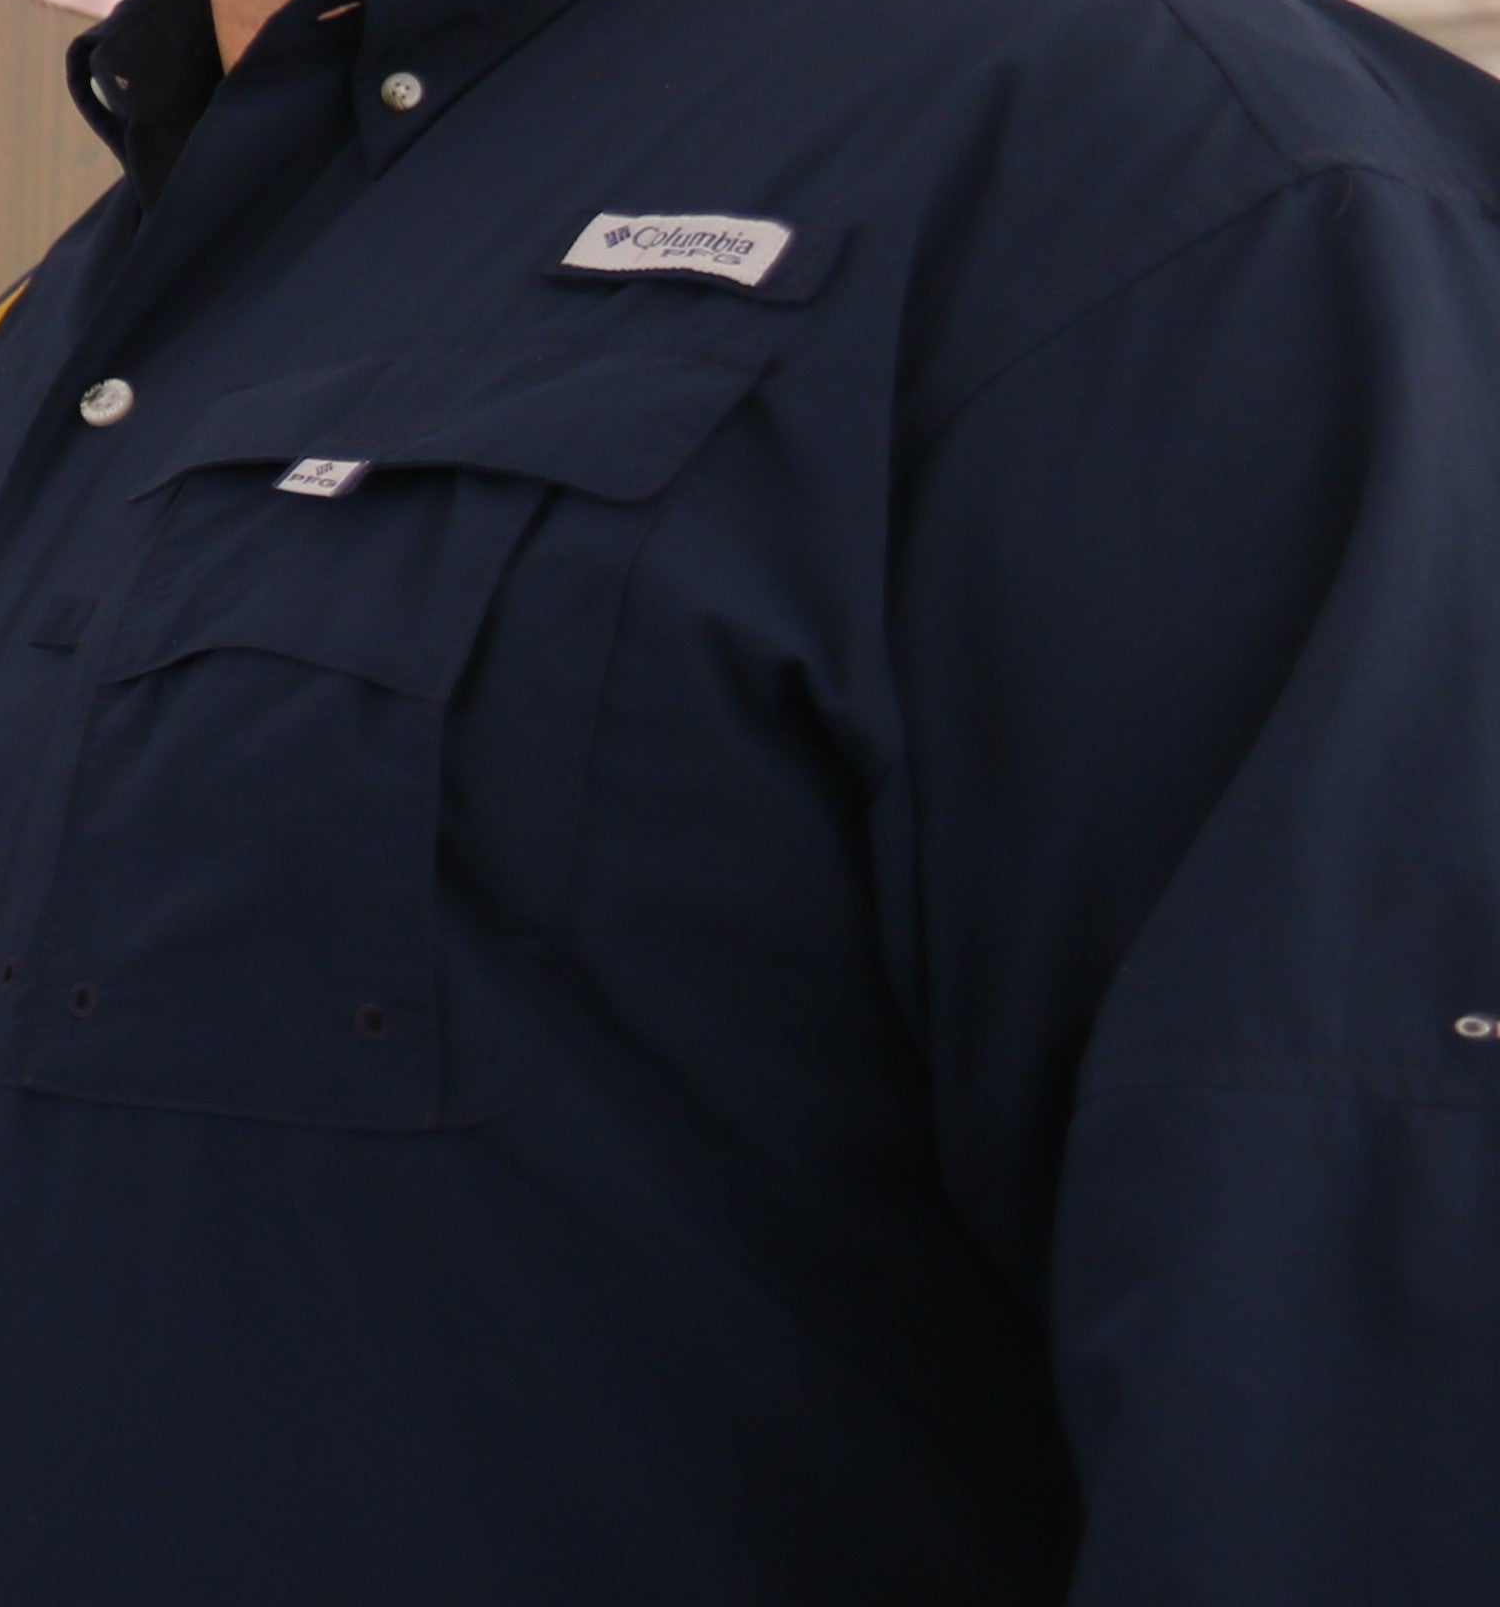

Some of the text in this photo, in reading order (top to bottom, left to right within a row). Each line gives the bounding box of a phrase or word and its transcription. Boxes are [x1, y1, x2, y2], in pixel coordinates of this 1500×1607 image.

[633, 226, 754, 255] Columbia
[661, 248, 743, 267] PFG
[288, 473, 338, 489] PFG
